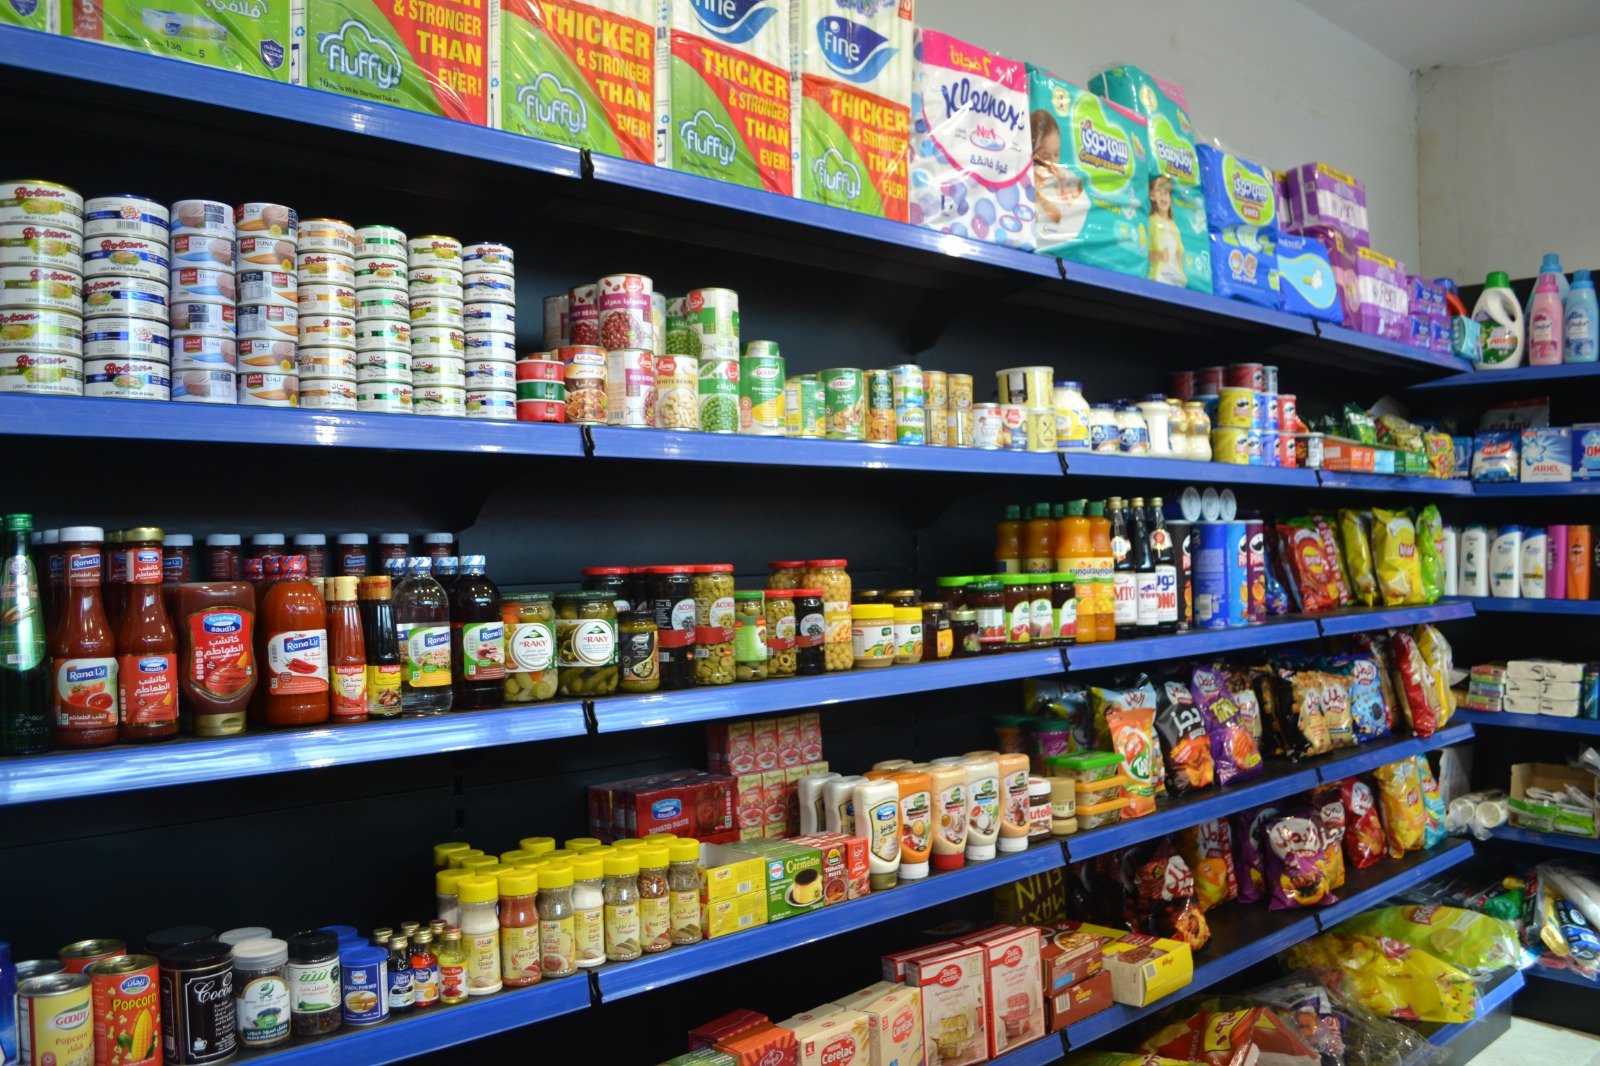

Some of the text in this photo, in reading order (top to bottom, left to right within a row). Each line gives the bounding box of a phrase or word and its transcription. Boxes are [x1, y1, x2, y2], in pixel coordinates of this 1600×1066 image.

[409, 0, 482, 38] STRONGER
[540, 1, 651, 61] THICKER
[416, 29, 482, 67] THAN
[329, 44, 393, 91] fluffy
[576, 47, 651, 86] & STRONGER
[701, 46, 789, 101] THICKER
[438, 68, 482, 97] EVER!
[595, 78, 651, 113] THAN
[728, 87, 789, 124] & STRONGER
[941, 78, 1025, 131] Kleenex
[526, 94, 582, 136] fluffy
[830, 89, 909, 133] THICKER
[616, 113, 652, 141] EVER!
[744, 117, 790, 150] THAN
[686, 128, 731, 167] fluffy
[863, 129, 908, 152] STRONGER
[759, 147, 791, 172] EVER!
[867, 152, 908, 178] THAN
[100, 239, 149, 252] Botan
[1532, 464, 1561, 473] ARIEL
[73, 558, 93, 569] Rana
[211, 625, 237, 634] saudia
[482, 630, 499, 642] Rana
[587, 635, 611, 645] RAKY
[209, 635, 241, 648] كاتشب
[286, 641, 310, 652] Rana
[427, 636, 446, 649] Rana
[524, 639, 548, 650] RAKY
[204, 644, 245, 663] الطماطم
[69, 668, 95, 683] Rana
[336, 666, 364, 675] Indofood
[648, 818, 691, 838] TOMATO PASTE
[786, 857, 821, 874] Carmelle
[194, 980, 233, 1004] Cocoa
[55, 1009, 88, 1026] GOODY
[55, 1032, 88, 1047] Popcorn
[821, 1045, 854, 1065] Cerelac
